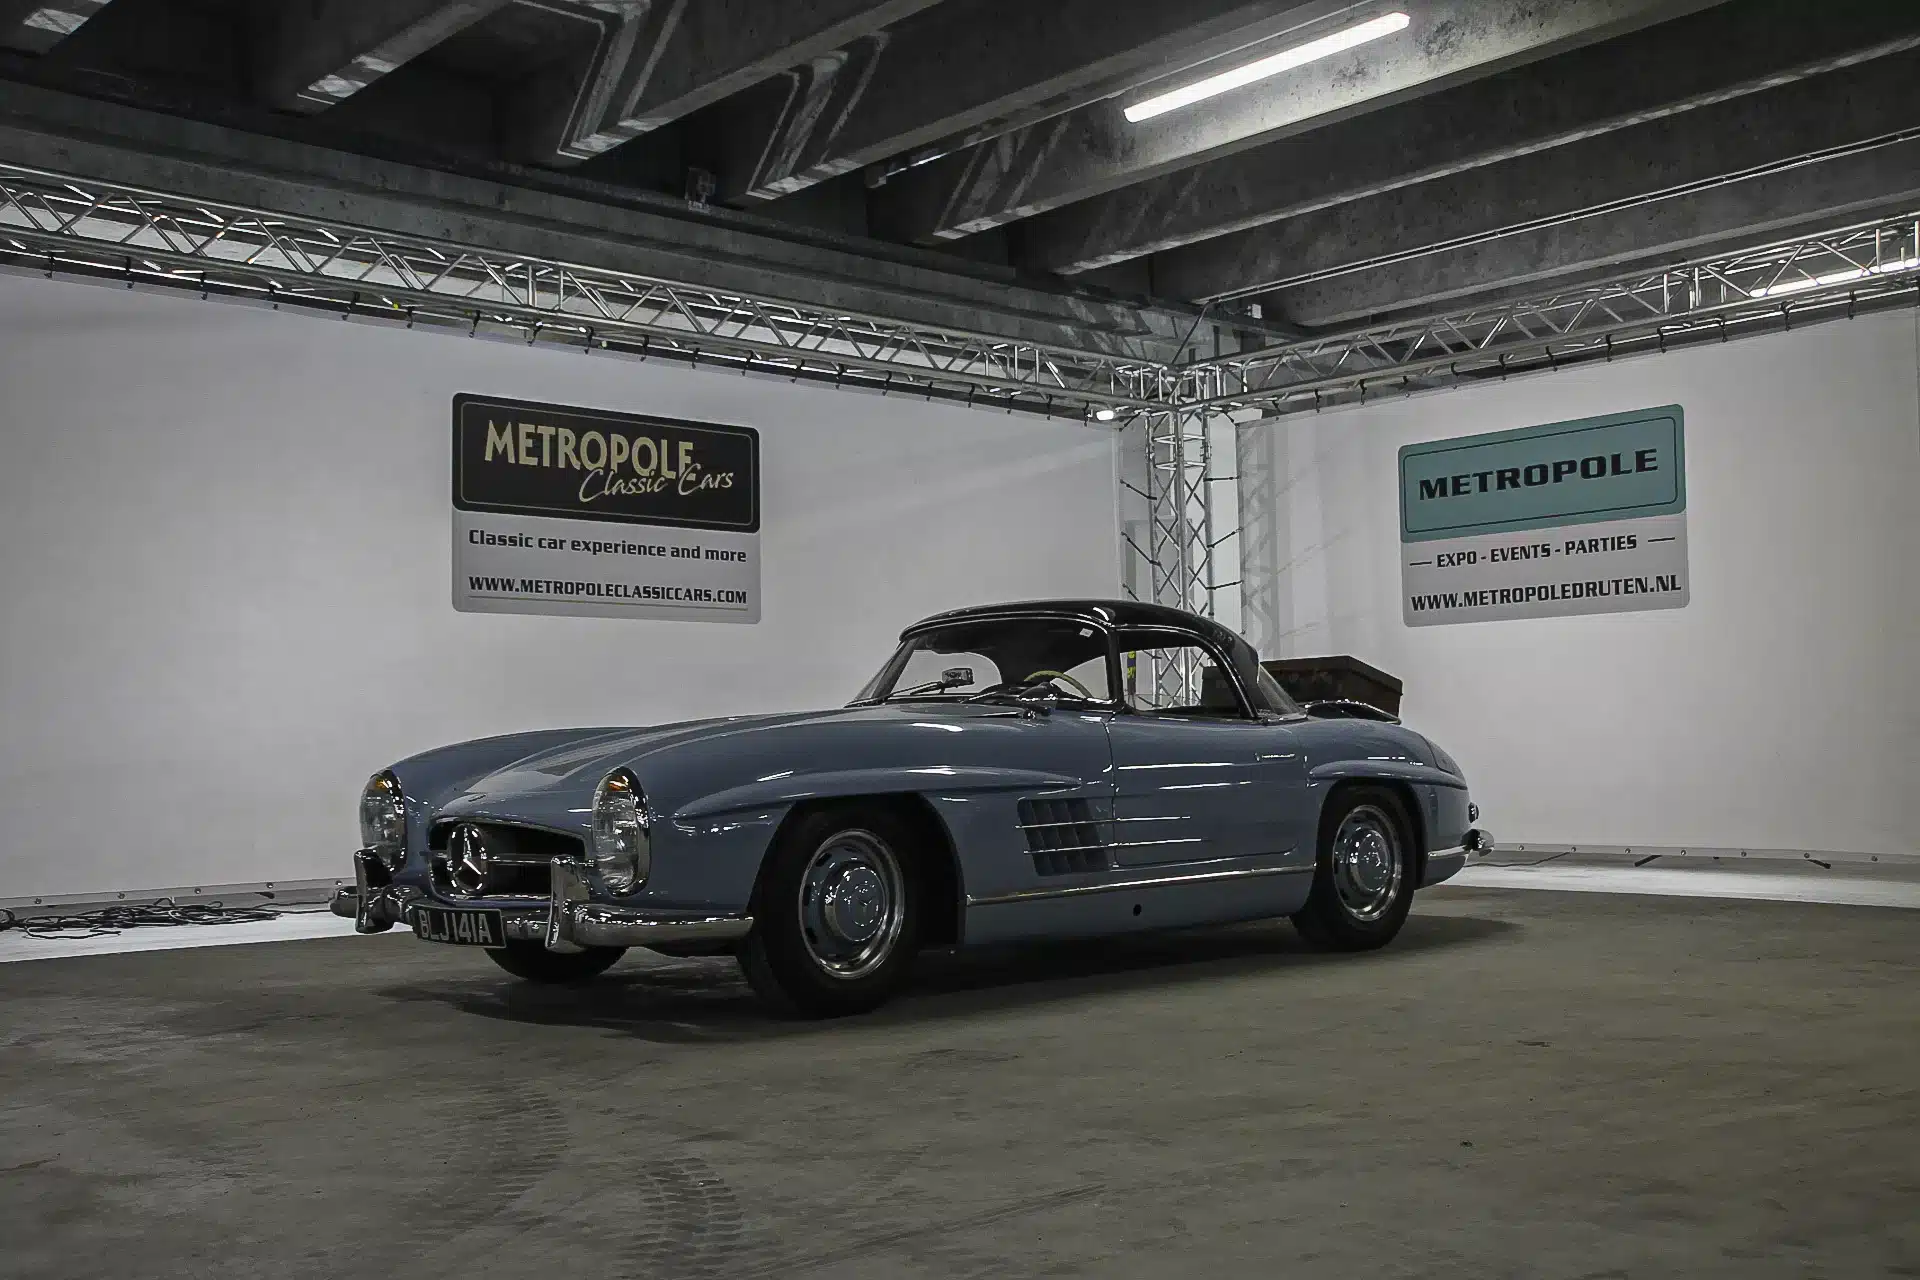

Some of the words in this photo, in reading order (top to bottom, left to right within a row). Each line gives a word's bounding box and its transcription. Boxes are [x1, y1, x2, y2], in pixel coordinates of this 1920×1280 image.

[484, 419, 695, 481] METROPOLE
[579, 468, 669, 503] Classic
[678, 463, 734, 496] Cars
[1419, 448, 1659, 501] METROPOLE
[468, 529, 534, 549] Classic
[537, 534, 567, 551] car
[571, 538, 667, 557] experience
[670, 545, 701, 560] and
[704, 549, 748, 563] more
[1436, 550, 1478, 568] EXPO
[1490, 543, 1551, 563] EVENTS
[1565, 534, 1638, 556] PARTIES
[468, 576, 748, 604] WWW.METROPOLECLASSICCARS.COM
[1410, 574, 1683, 611] WWW.METROPOLEDRUTEN.NL
